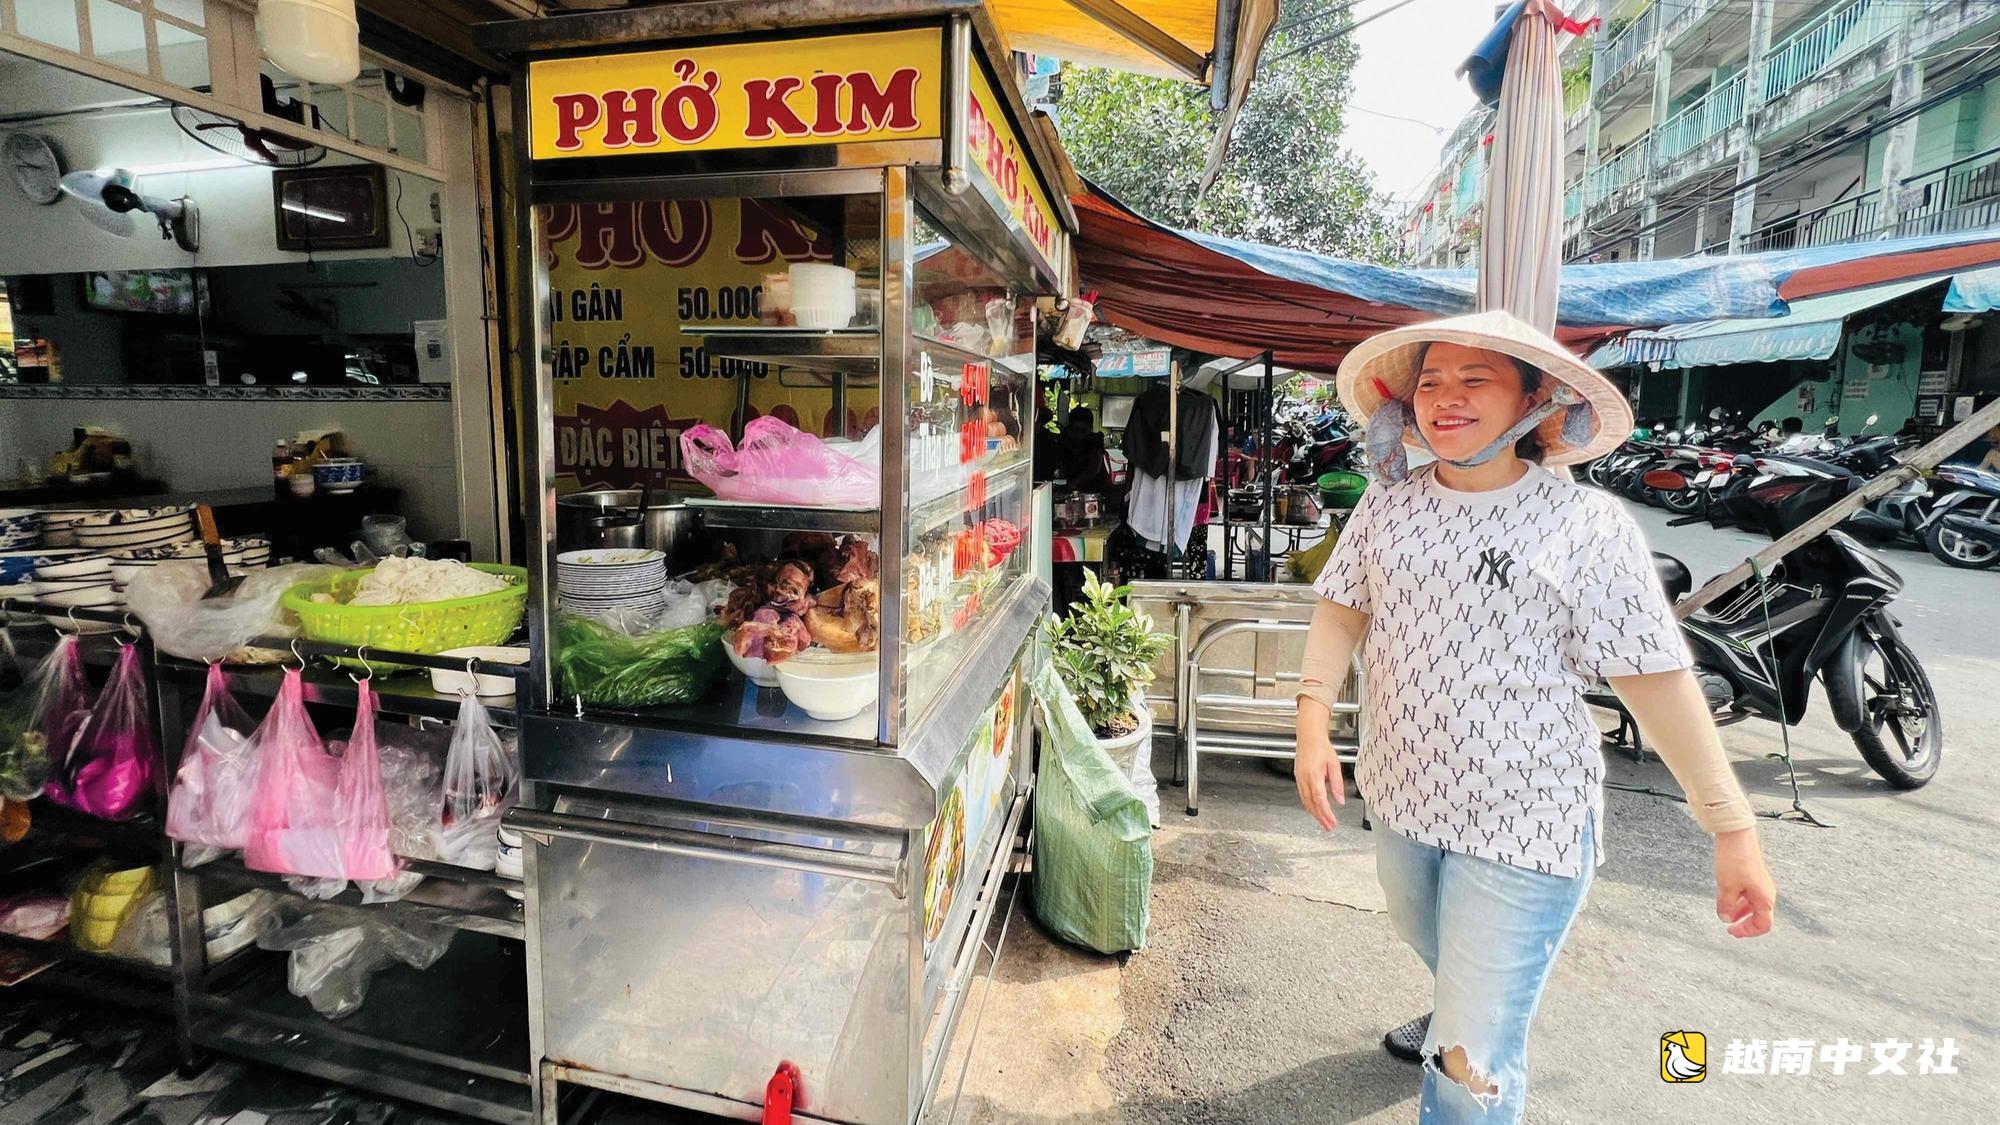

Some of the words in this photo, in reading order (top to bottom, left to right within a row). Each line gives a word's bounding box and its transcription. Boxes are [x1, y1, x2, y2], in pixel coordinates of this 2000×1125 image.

[552, 58, 720, 150] PHỞ
[743, 67, 921, 140] KIM
[969, 88, 1019, 208] PHỞ
[1022, 184, 1050, 257] KIM
[571, 283, 623, 322] GÂN
[678, 286, 764, 321] 50.000
[598, 332, 656, 379] CẨM
[560, 418, 615, 476] ĐẶC
[622, 419, 682, 478] BIỆT
